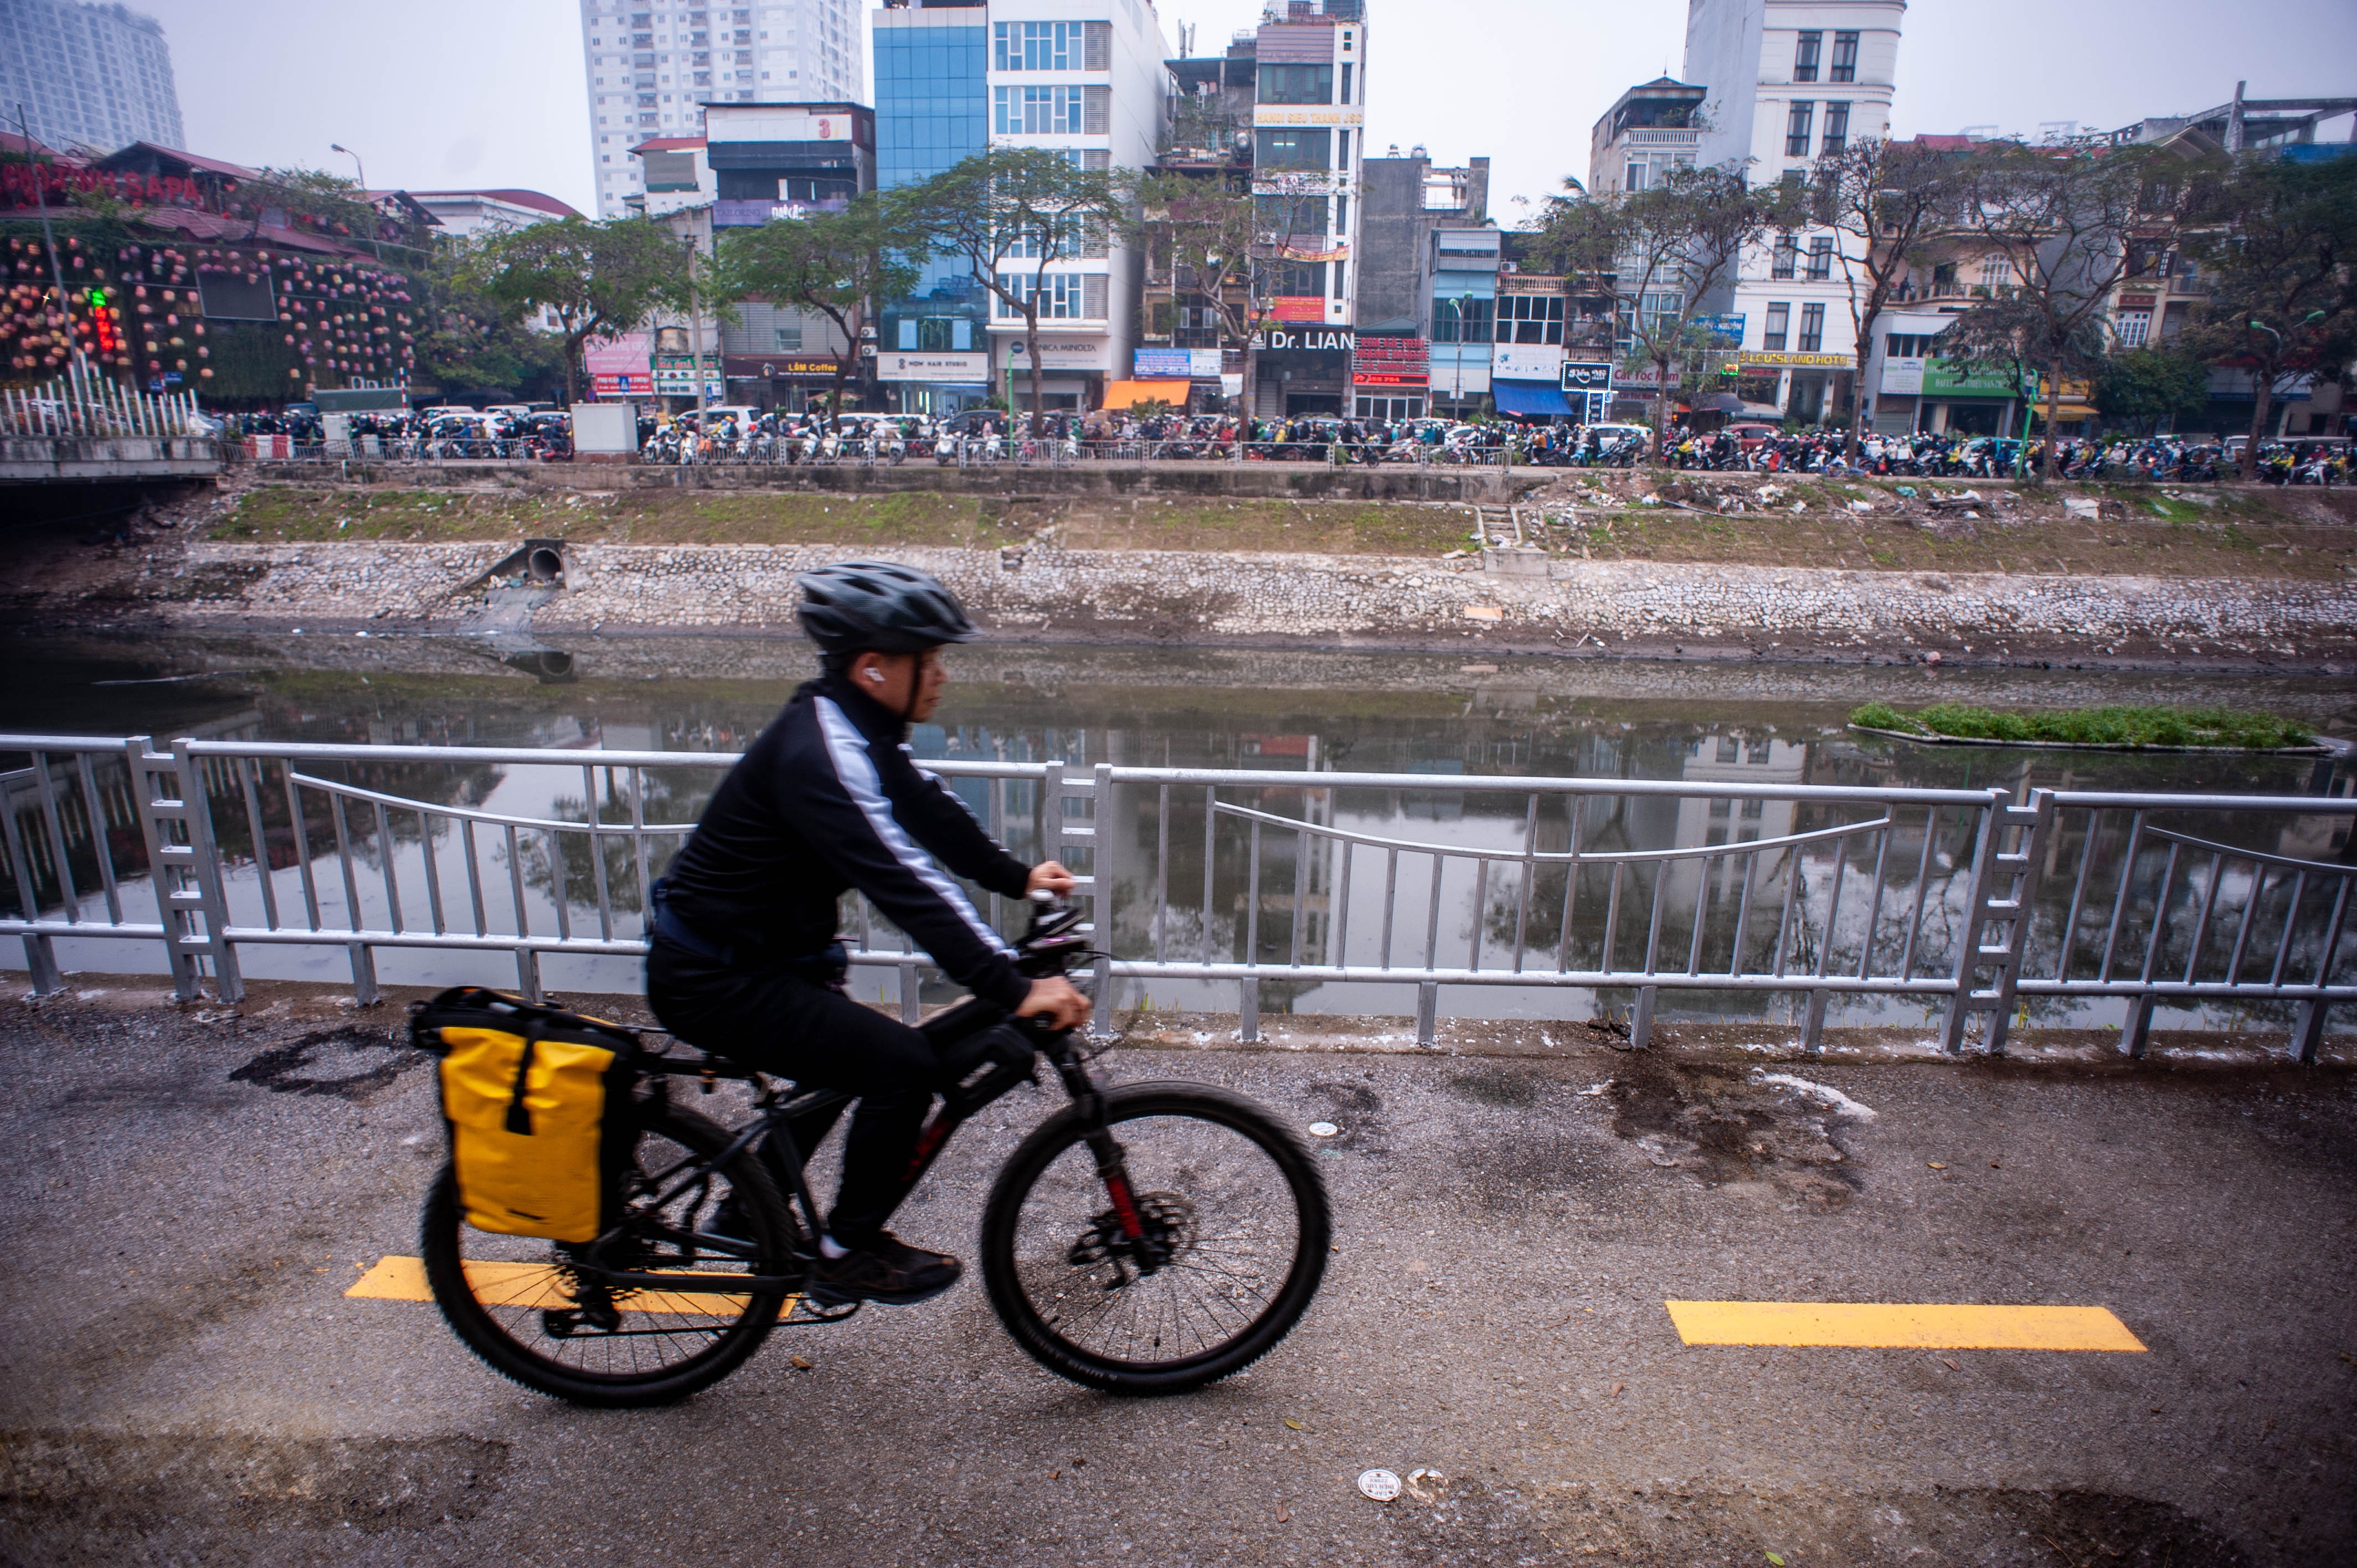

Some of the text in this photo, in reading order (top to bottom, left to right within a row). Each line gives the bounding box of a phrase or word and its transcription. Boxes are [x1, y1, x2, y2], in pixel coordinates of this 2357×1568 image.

[1344, 113, 1362, 123] JSC
[1272, 331, 1299, 349] Dr.
[1305, 332, 1355, 350] LIAN
[1060, 344, 1097, 352] MINOLTA
